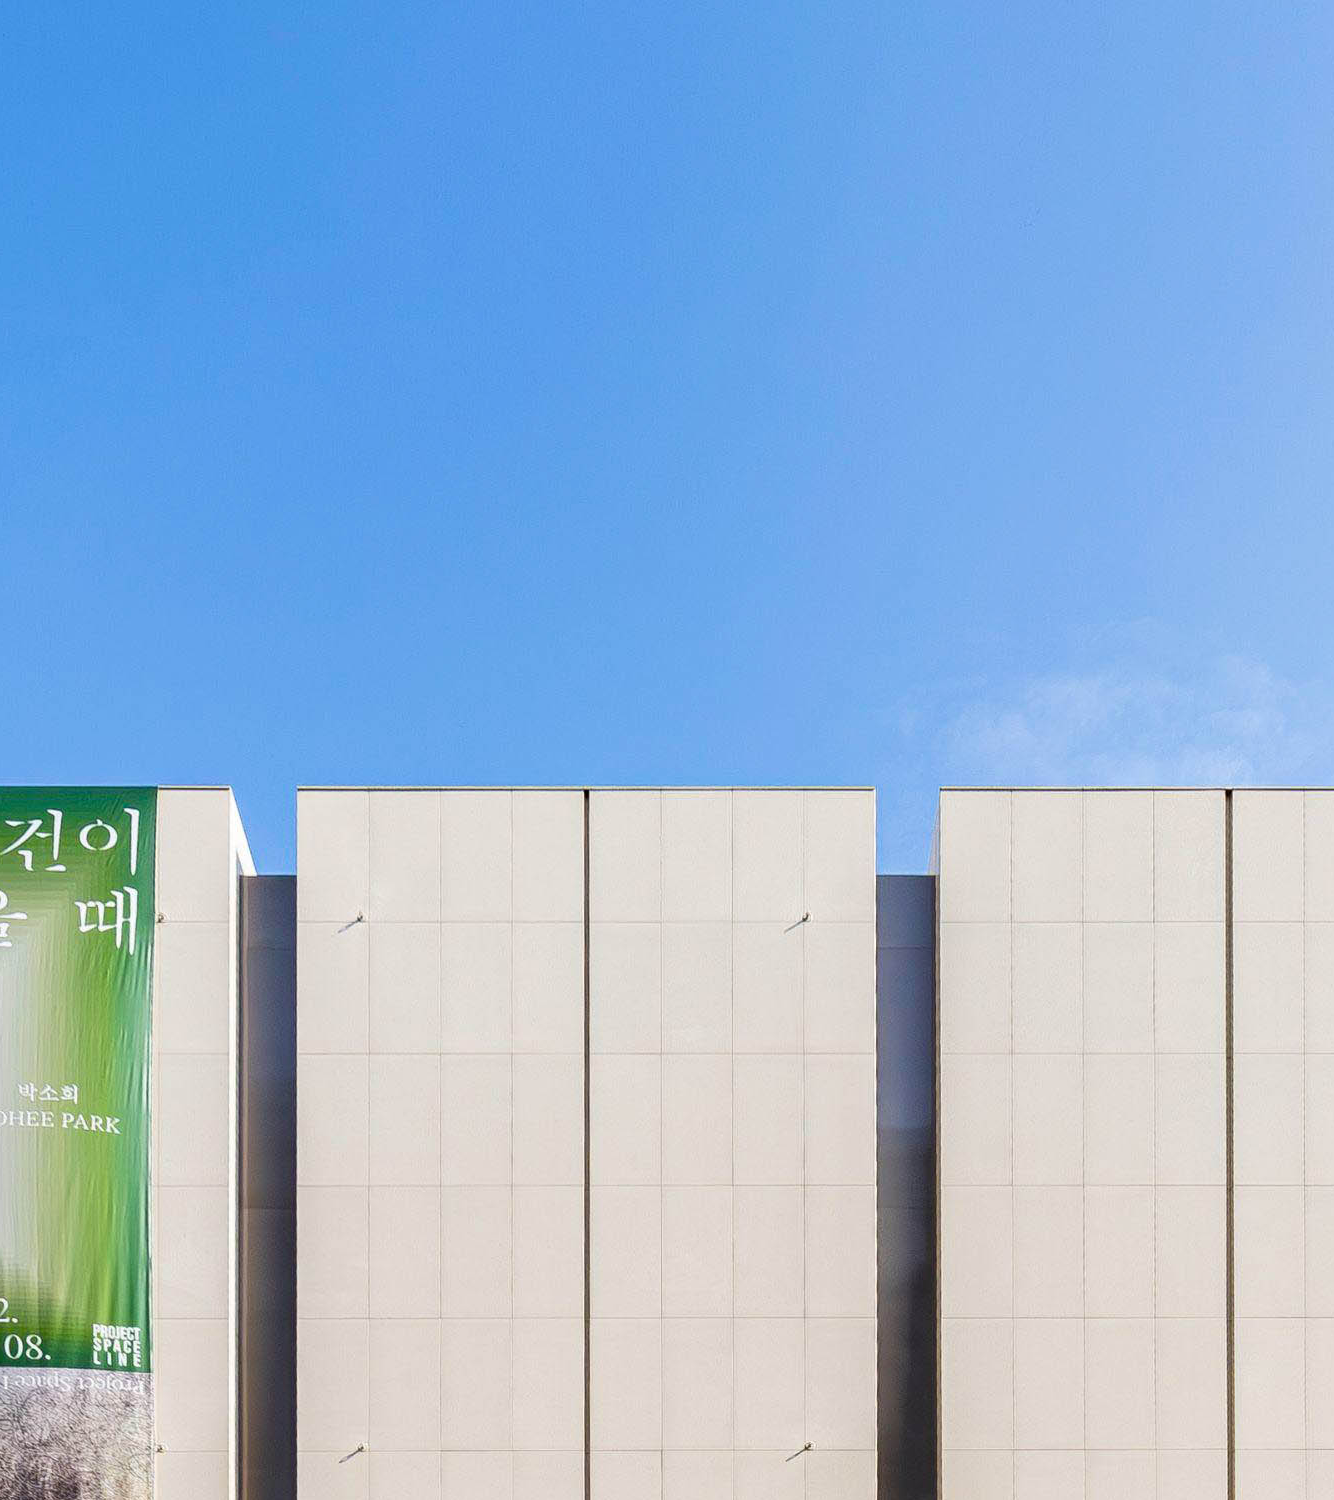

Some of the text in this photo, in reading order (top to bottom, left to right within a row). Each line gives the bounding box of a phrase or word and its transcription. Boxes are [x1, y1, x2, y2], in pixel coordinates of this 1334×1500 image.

[74, 886, 140, 956] 때
[17, 1082, 79, 1105] 박소희
[61, 1112, 122, 1135] PARK
[91, 1323, 142, 1341] PROJECT
[4, 1334, 52, 1361] 08.
[92, 1337, 142, 1354] SPACE
[92, 1350, 142, 1368] LINE
[14, 1373, 72, 1392] Space
[78, 1375, 147, 1396] Project
